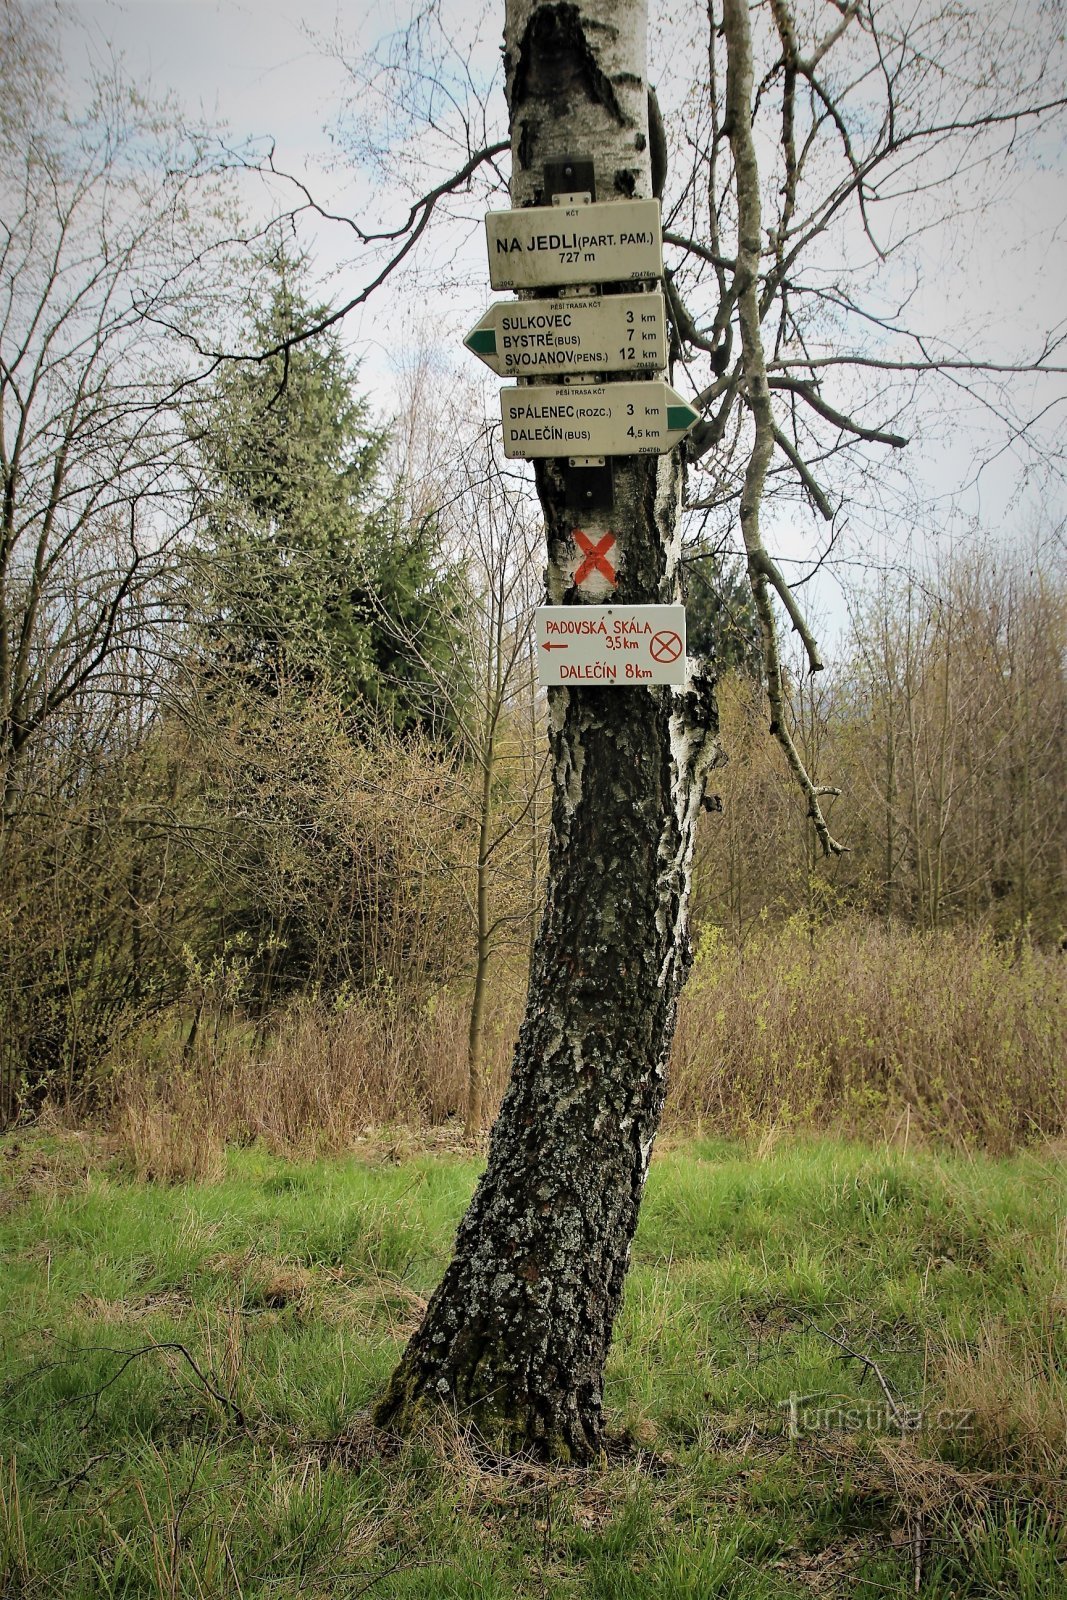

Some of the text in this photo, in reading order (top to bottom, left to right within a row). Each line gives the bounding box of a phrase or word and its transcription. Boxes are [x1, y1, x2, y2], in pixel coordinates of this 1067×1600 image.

[565, 209, 579, 217] KČT
[496, 237, 522, 254] NA
[620, 231, 654, 246] PAM.)
[558, 252, 596, 264] 727 m
[502, 311, 656, 330] SULKOVEC 3 km
[627, 329, 635, 341] 7
[641, 331, 657, 340] km
[619, 347, 636, 360] 12
[642, 349, 658, 359] km
[626, 404, 635, 416] 3
[645, 407, 660, 415] km
[626, 426, 643, 439] 4,5
[645, 428, 660, 438] km
[546, 616, 653, 635] PADOVSKÁ SKÁLA
[560, 661, 617, 679] DALEČÍN
